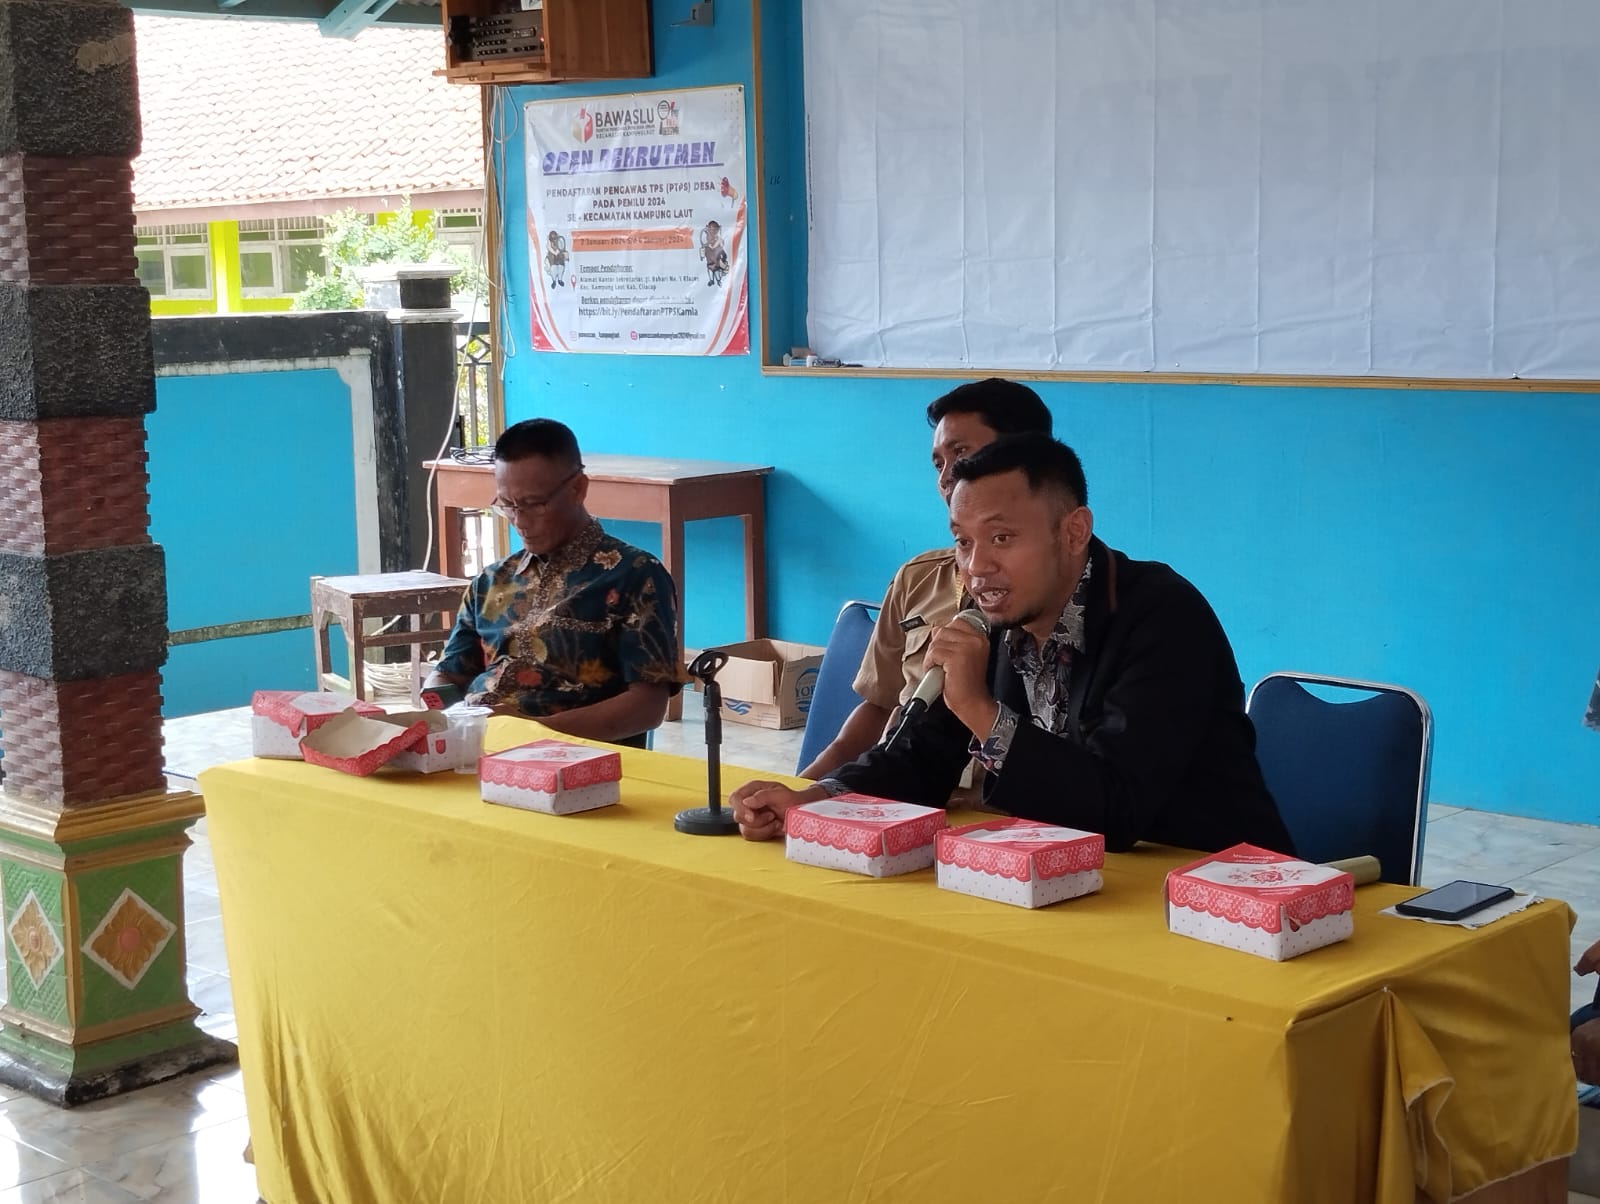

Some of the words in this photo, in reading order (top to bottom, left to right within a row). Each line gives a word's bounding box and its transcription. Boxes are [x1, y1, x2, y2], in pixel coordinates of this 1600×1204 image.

[595, 107, 655, 128] BAWASLU
[603, 184, 647, 196] PENGAWAS
[649, 184, 664, 194] TPS
[666, 181, 691, 194] (PTPS)
[694, 181, 715, 191] DESA
[592, 200, 615, 209] PADA
[617, 198, 645, 207] PEMILU
[647, 197, 666, 206] 2024
[583, 212, 631, 222] KECAMATAN
[633, 210, 672, 220] KAMPUNG
[673, 209, 694, 218] LAUT
